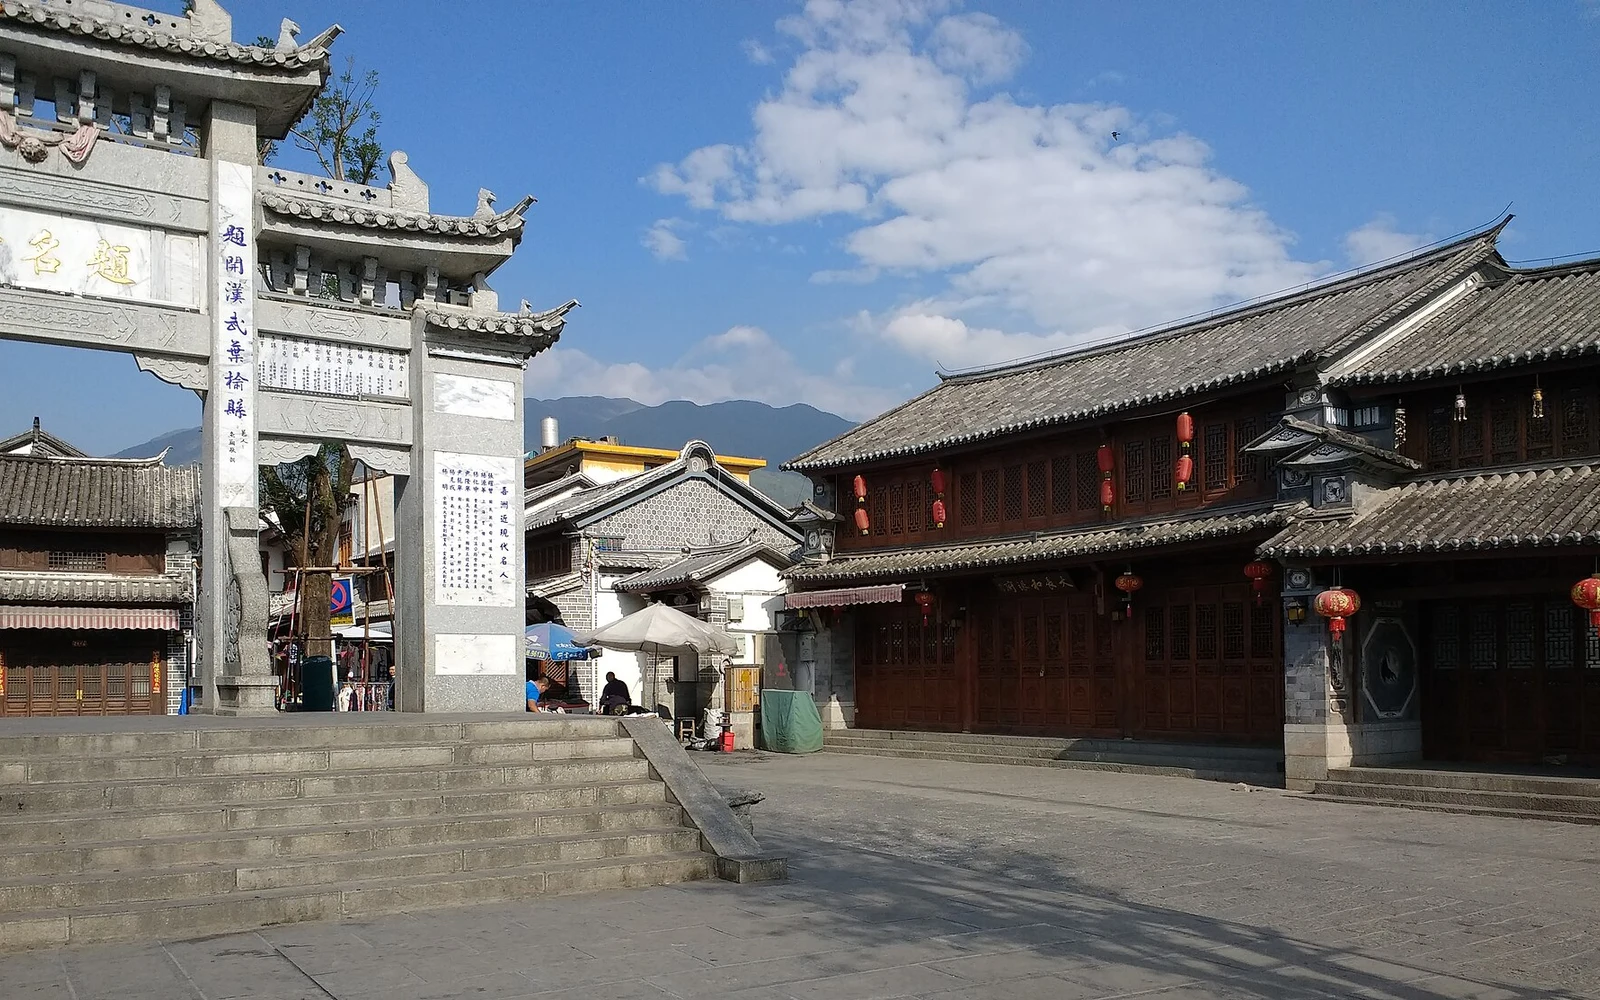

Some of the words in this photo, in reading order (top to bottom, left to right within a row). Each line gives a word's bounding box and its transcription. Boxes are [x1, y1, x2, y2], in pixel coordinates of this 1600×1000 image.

[0, 229, 136, 285] 題名
[499, 486, 509, 579] 喜洲近現代名人
